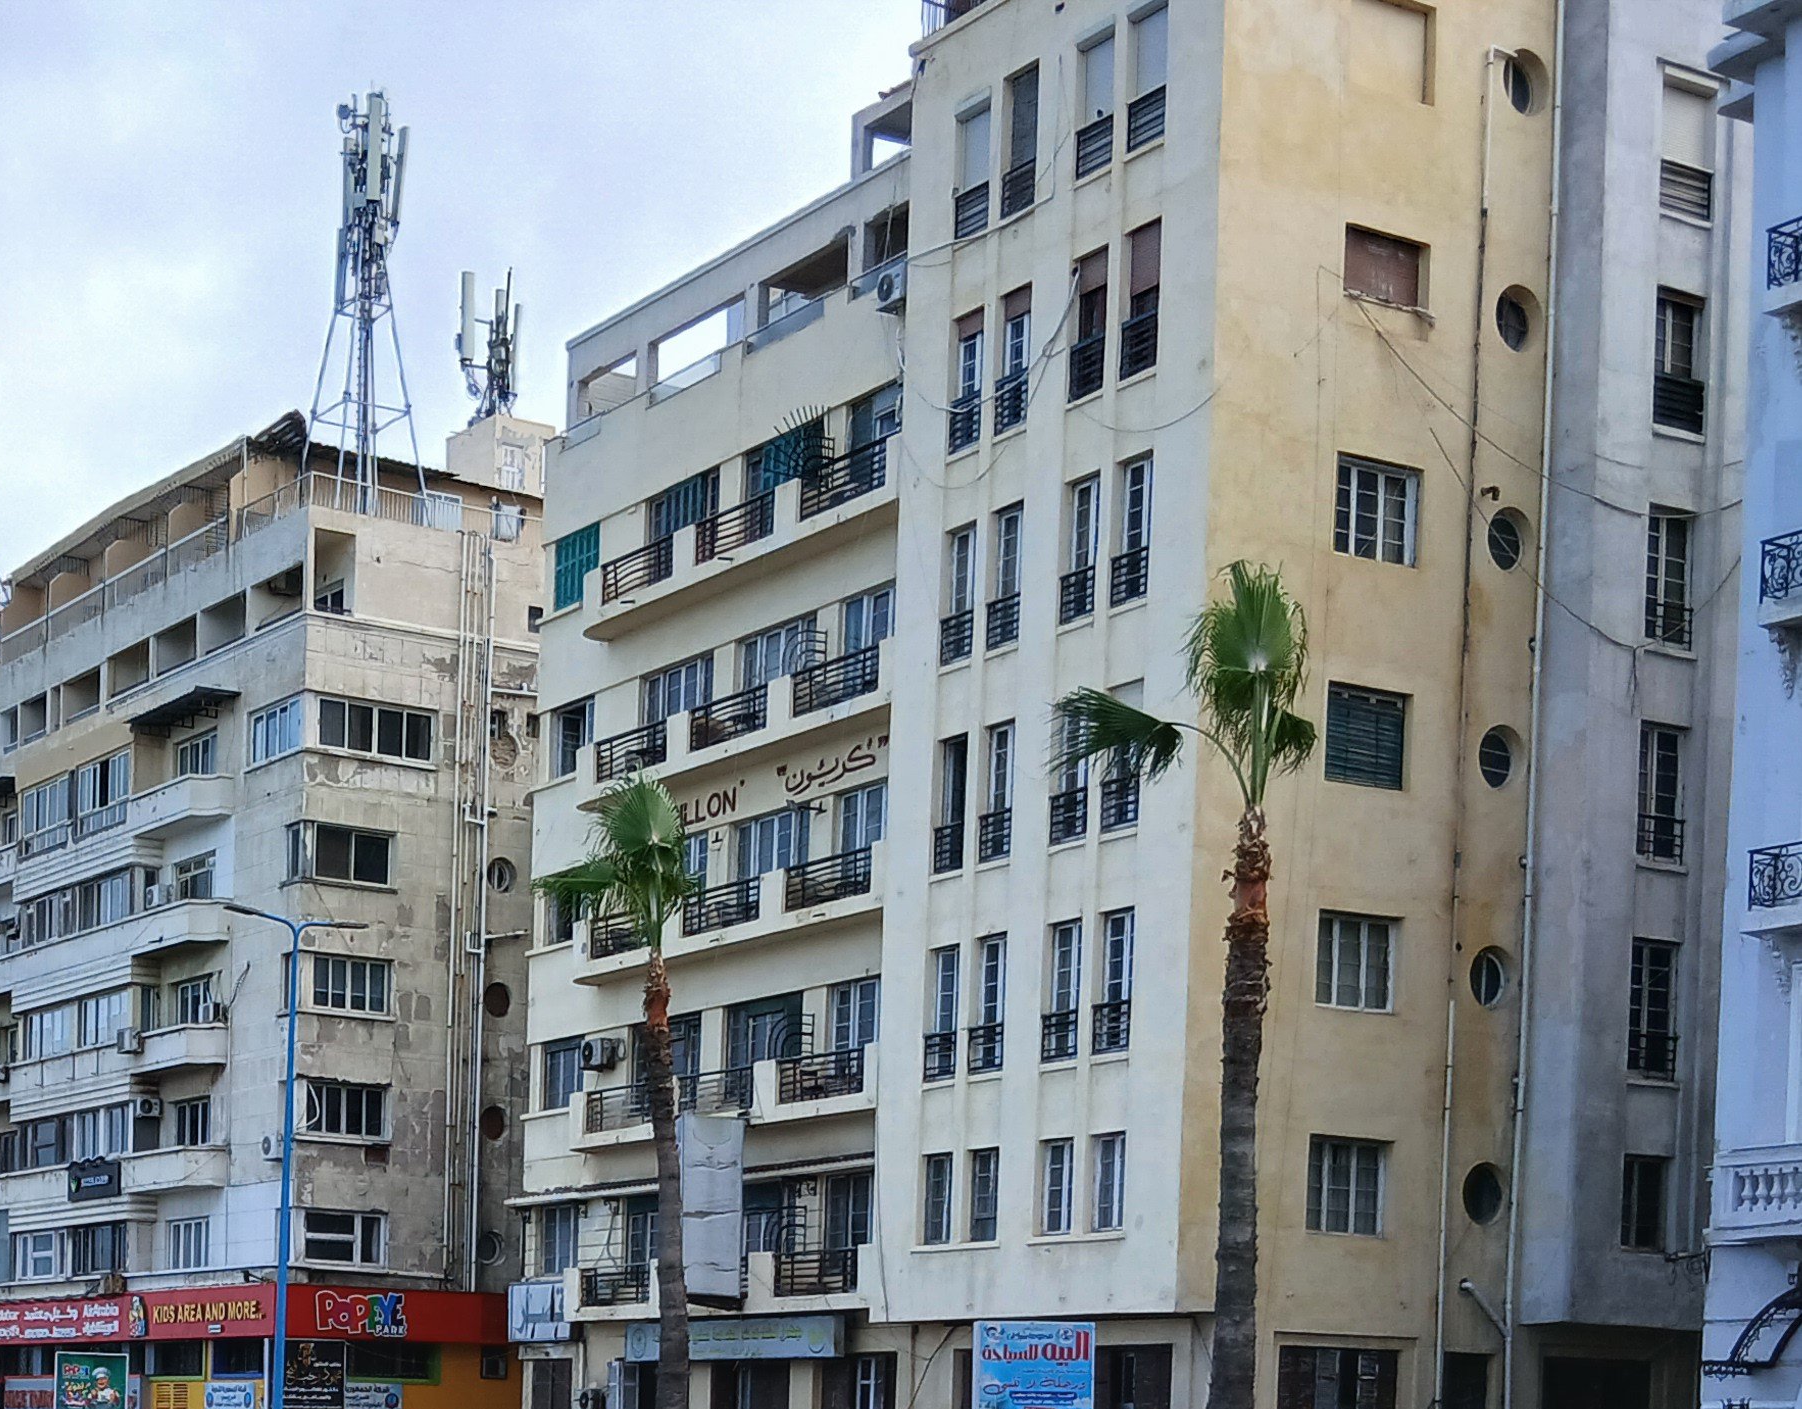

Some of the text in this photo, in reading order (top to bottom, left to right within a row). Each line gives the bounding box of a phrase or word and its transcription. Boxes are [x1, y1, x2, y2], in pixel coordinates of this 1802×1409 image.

[152, 1304, 176, 1324] KIDS
[177, 1303, 203, 1323] AREA
[204, 1301, 226, 1322] AND
[375, 1324, 405, 1335] PARK
